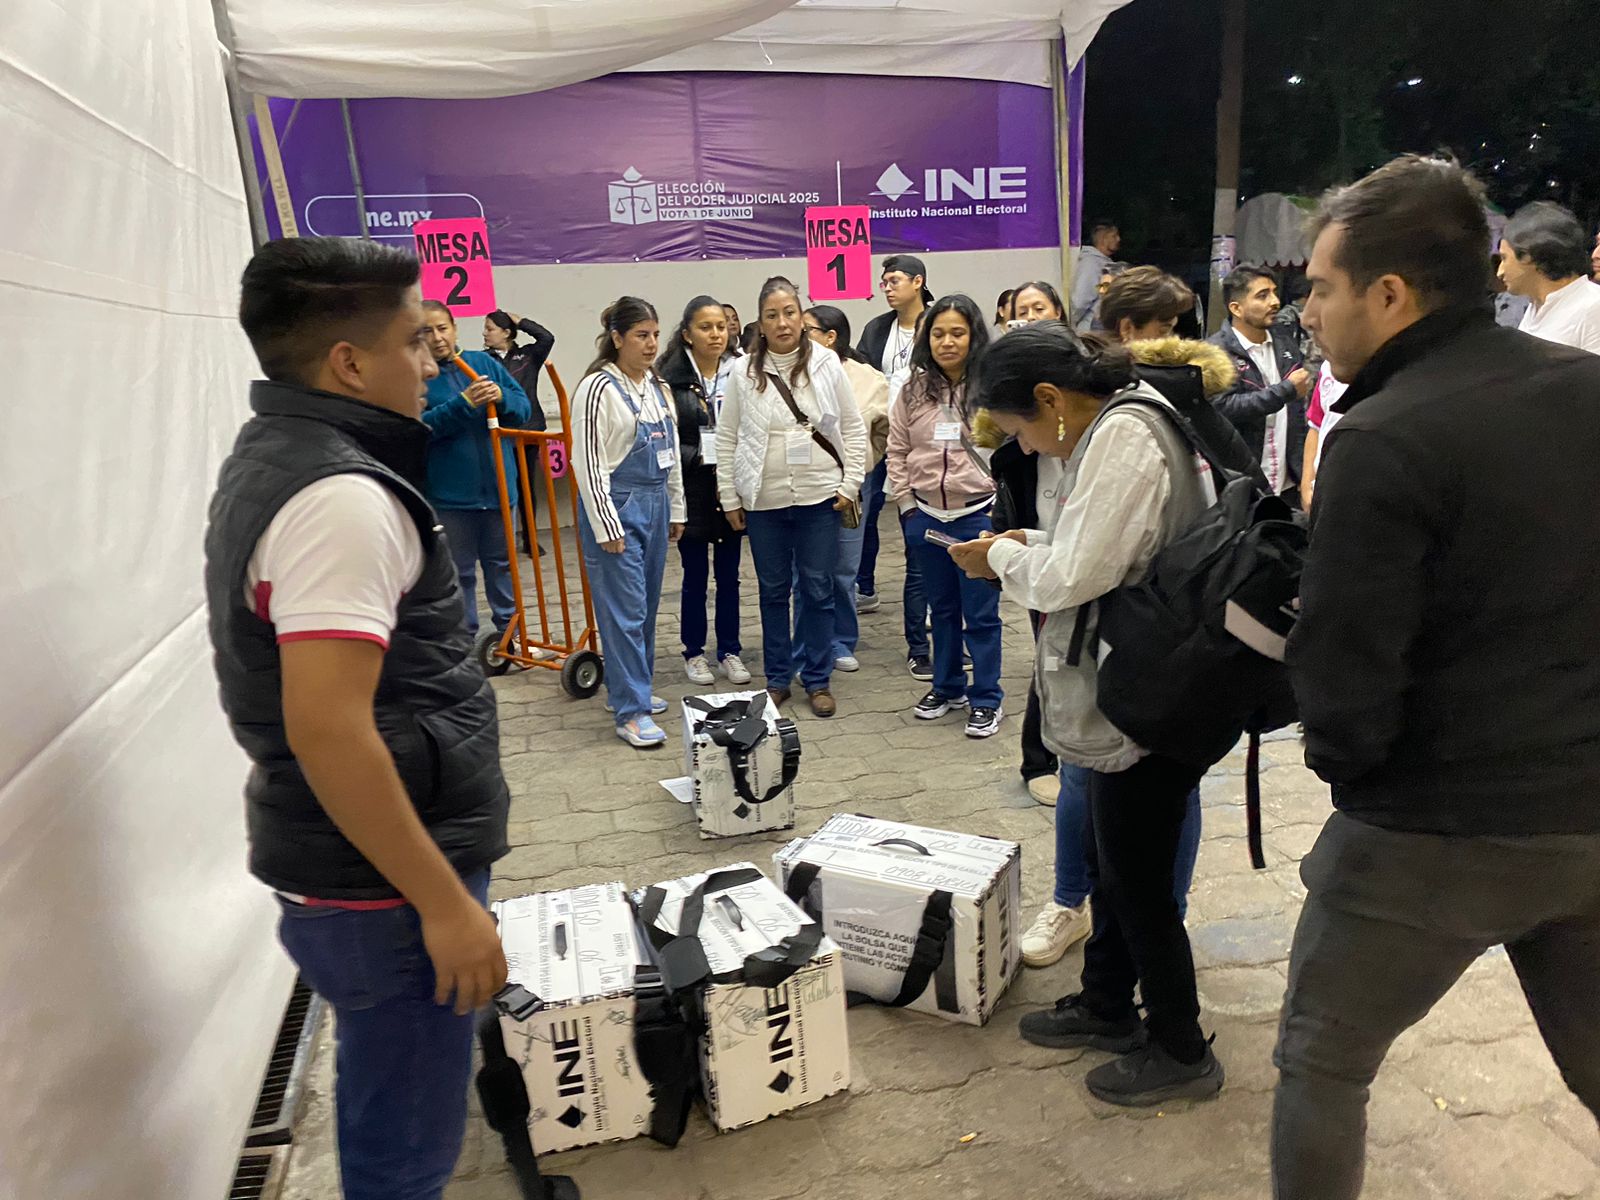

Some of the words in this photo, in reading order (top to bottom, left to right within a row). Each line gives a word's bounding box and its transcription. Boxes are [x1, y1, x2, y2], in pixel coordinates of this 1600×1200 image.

[657, 180, 726, 194] ELECCIÓN
[925, 166, 1026, 201] INE
[658, 196, 681, 206] DEL
[684, 195, 726, 206] PODER
[728, 193, 787, 206] JUDICIAL
[788, 192, 820, 204] 2025
[870, 207, 918, 219] Instituto
[922, 204, 972, 216] Nacional
[976, 203, 1026, 215] Electoral
[660, 209, 690, 219] VOTA
[692, 209, 698, 218] 1
[701, 208, 714, 218] DE
[716, 208, 752, 218] JUNIO
[808, 218, 869, 248] MESA
[416, 232, 489, 264] MESA
[444, 266, 472, 306] 2
[826, 254, 846, 292] 1
[550, 448, 563, 473] 3
[834, 920, 891, 940] INTRODUZCA
[842, 932, 852, 941] LA
[854, 935, 886, 949] BOLSA
[888, 942, 908, 954] QUE
[763, 983, 793, 1063] INE
[550, 1019, 584, 1097] INE
